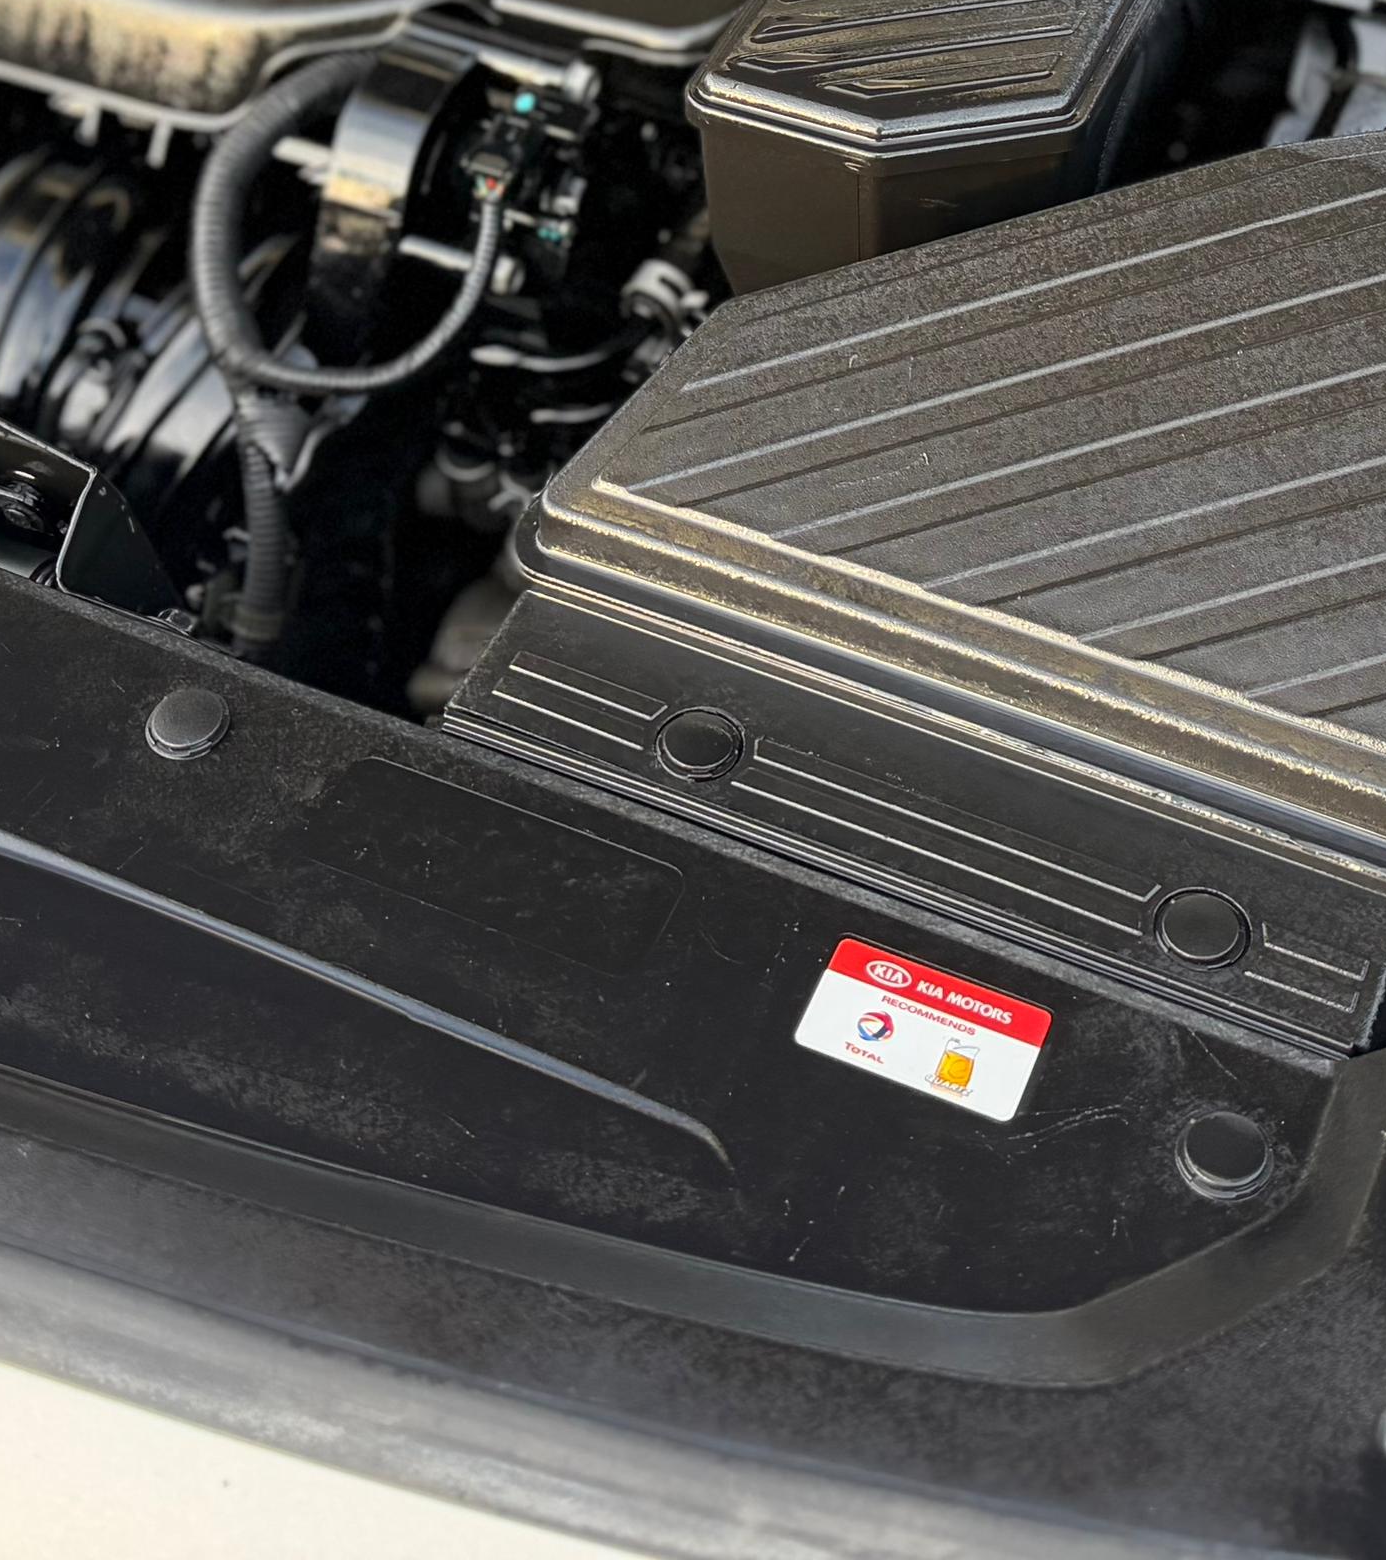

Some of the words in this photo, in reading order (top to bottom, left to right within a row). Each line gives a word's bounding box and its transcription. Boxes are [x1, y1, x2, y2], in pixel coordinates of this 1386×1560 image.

[872, 962, 906, 985] KIA
[916, 980, 944, 1001] KIA
[946, 987, 1013, 1025] MOTORS
[881, 994, 976, 1036] RECOMMENDS
[844, 1041, 884, 1064] TOTAL
